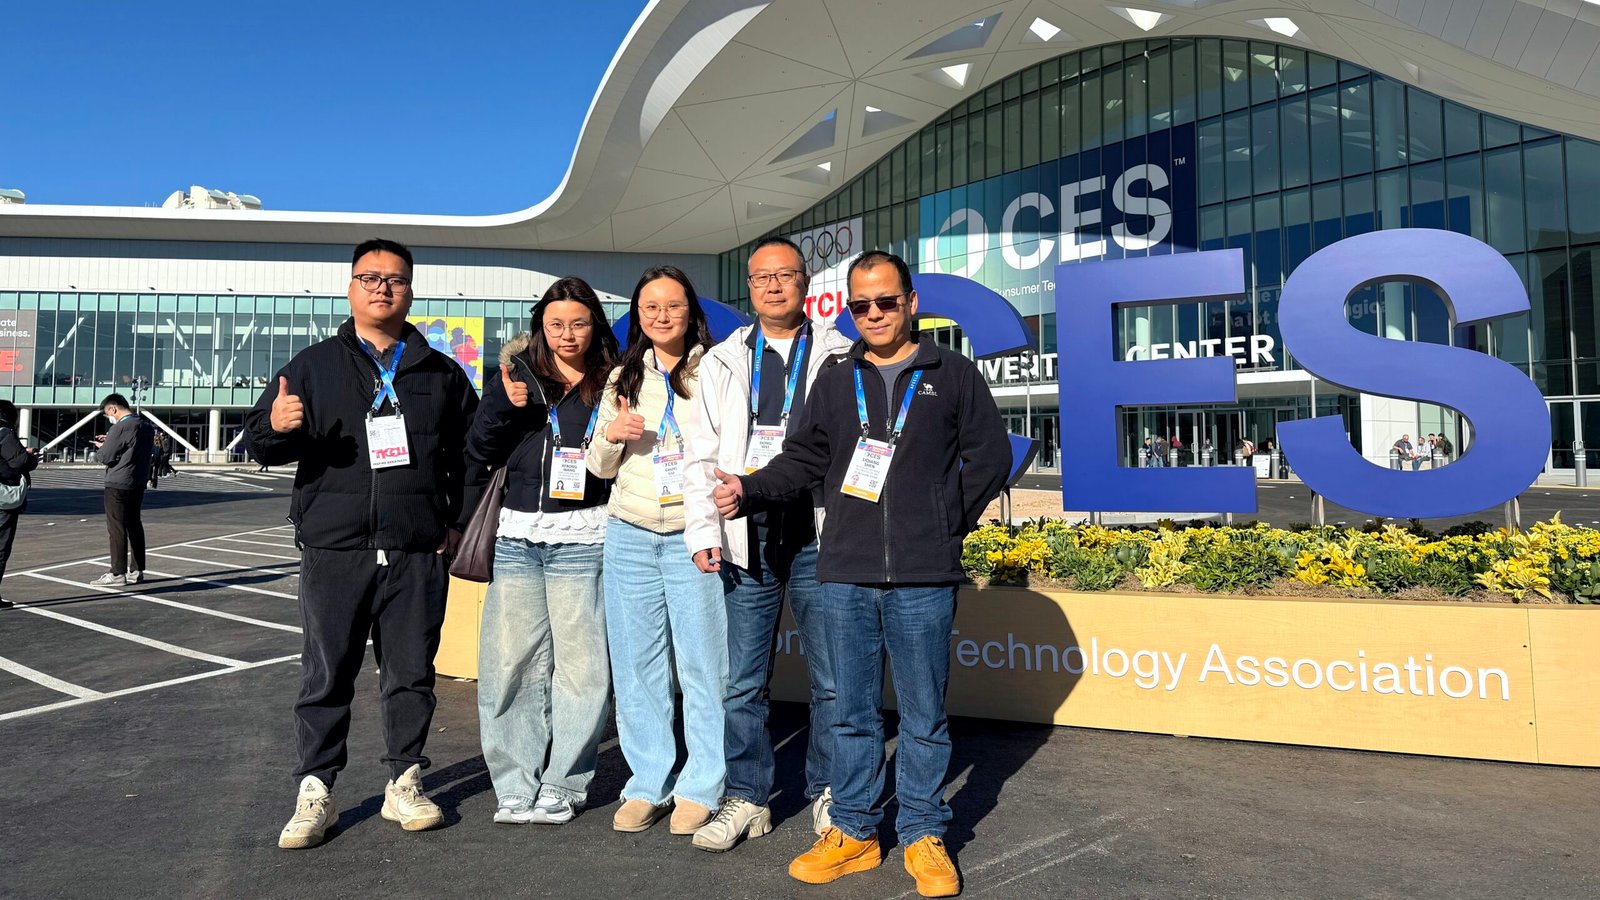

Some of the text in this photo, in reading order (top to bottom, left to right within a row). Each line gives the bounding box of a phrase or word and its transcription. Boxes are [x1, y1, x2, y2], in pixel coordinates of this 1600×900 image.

[1002, 163, 1172, 270] CES
[804, 291, 844, 319] TCL
[1199, 643, 1510, 700] Association
